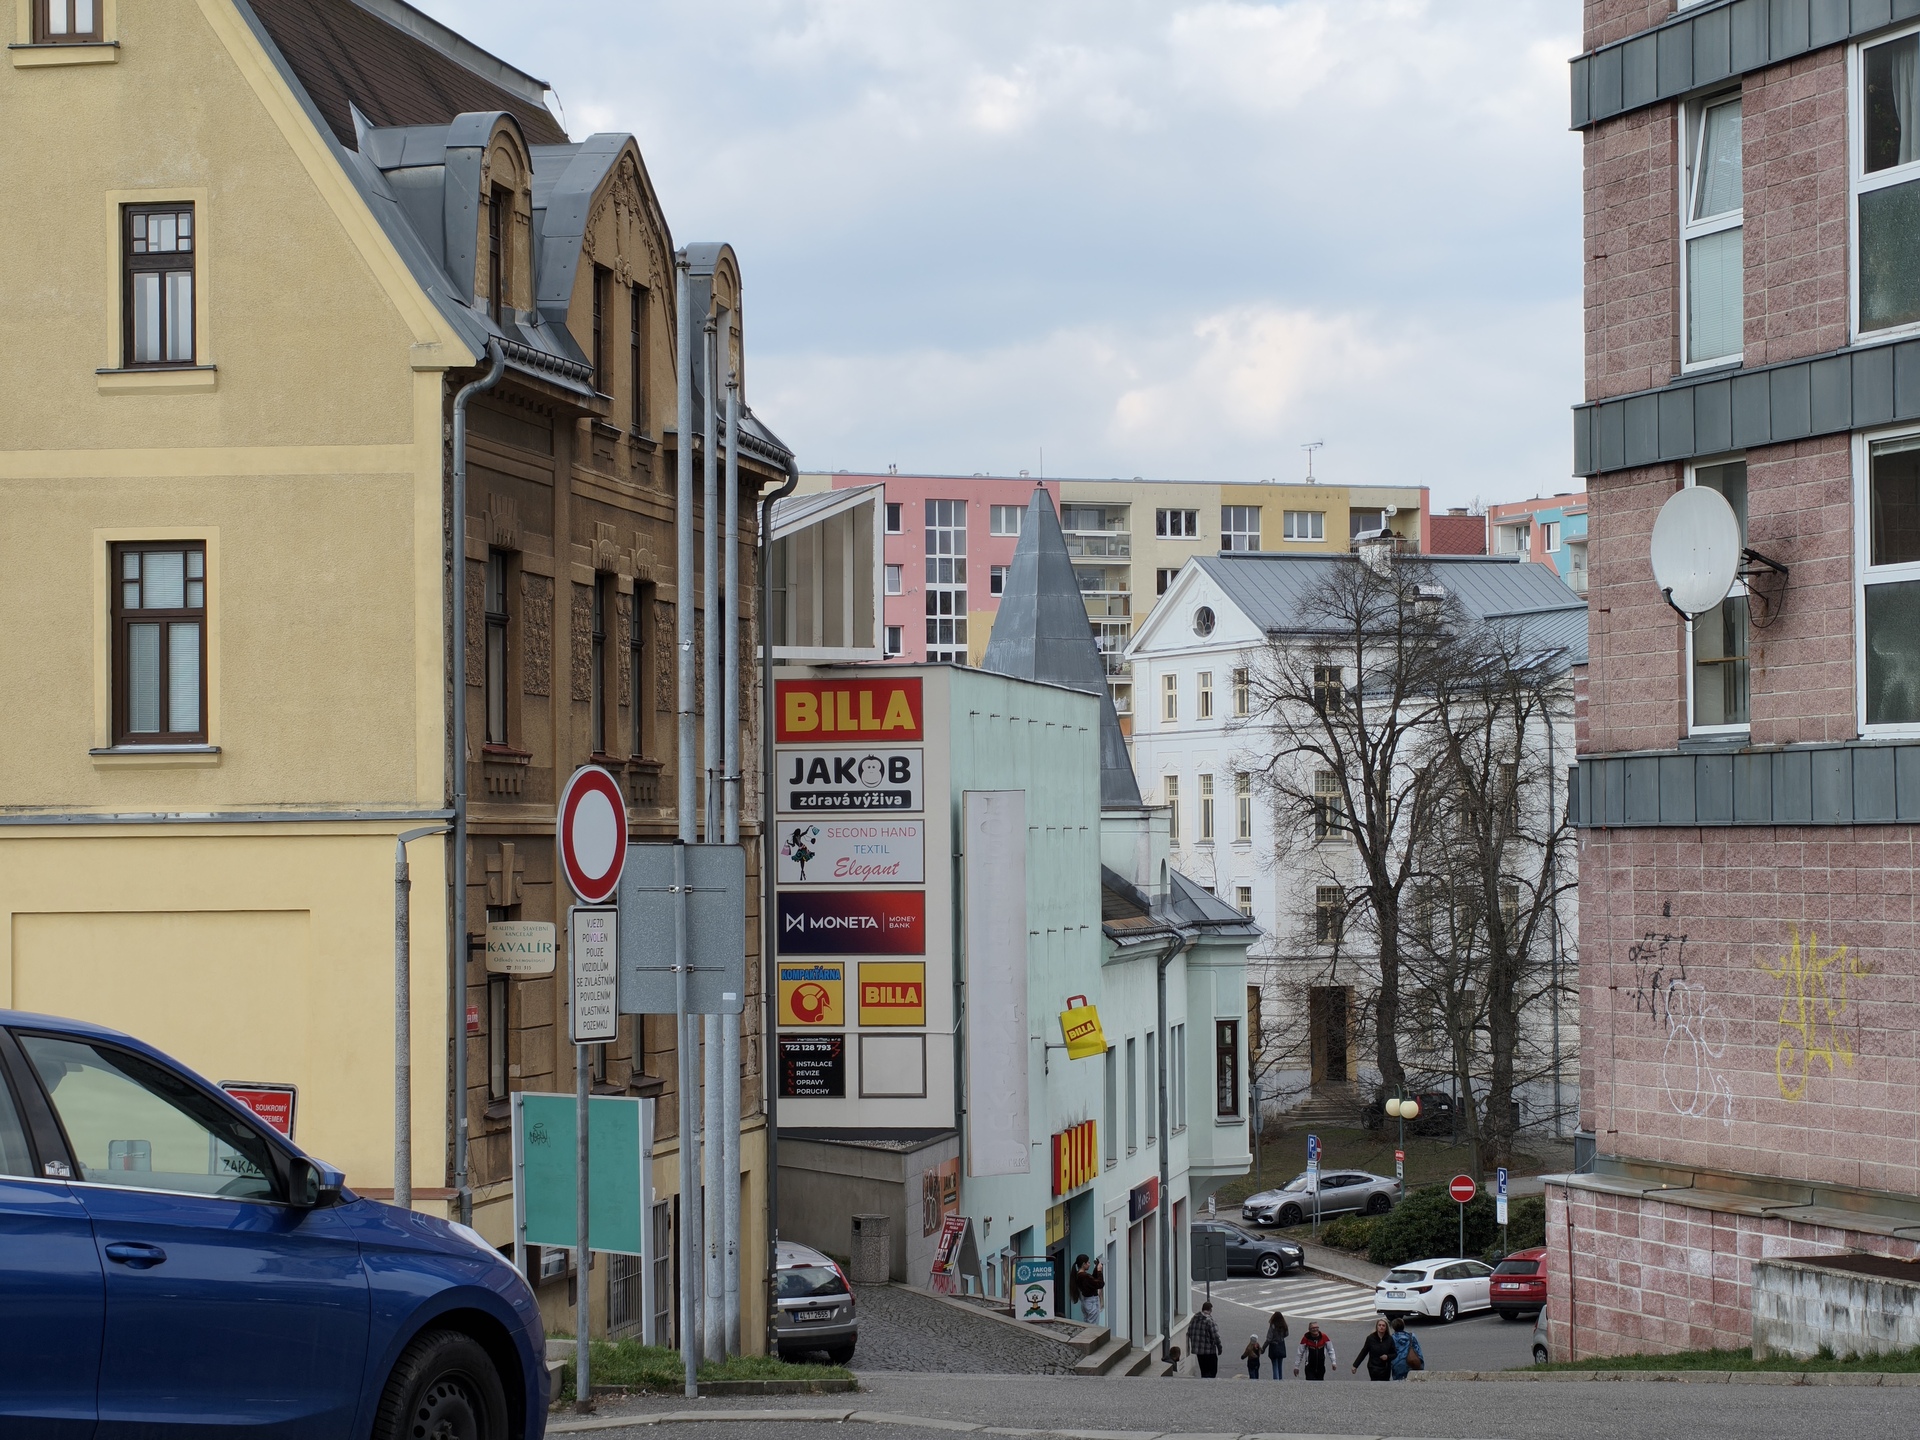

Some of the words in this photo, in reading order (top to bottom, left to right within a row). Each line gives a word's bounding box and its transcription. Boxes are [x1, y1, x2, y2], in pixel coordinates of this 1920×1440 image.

[785, 690, 916, 732] BILLA
[789, 755, 911, 788] JAKOB
[800, 793, 850, 806] zdravá
[853, 792, 902, 808] výživa
[827, 827, 877, 838] SECOND
[881, 827, 917, 838] HAND
[853, 844, 890, 854] TEXTIL
[833, 857, 900, 881] Elegant
[586, 919, 604, 928] VJEZD
[810, 916, 879, 929] MONETA
[582, 933, 608, 943] POVOLEN
[487, 940, 552, 953] KAVALÍR
[586, 948, 604, 957] POUZE
[582, 959, 609, 972] VOZIDLŮM
[576, 977, 583, 987] SE
[580, 989, 611, 1001] POVOLENÍM
[865, 986, 919, 1004] BILLA
[581, 1004, 610, 1016] VLASTNÍKA
[583, 1021, 608, 1030] POZEMKU
[1068, 1022, 1094, 1040] BILLA
[255, 1103, 287, 1112] SOUKROMÝ
[1060, 1119, 1098, 1195] BILLA
